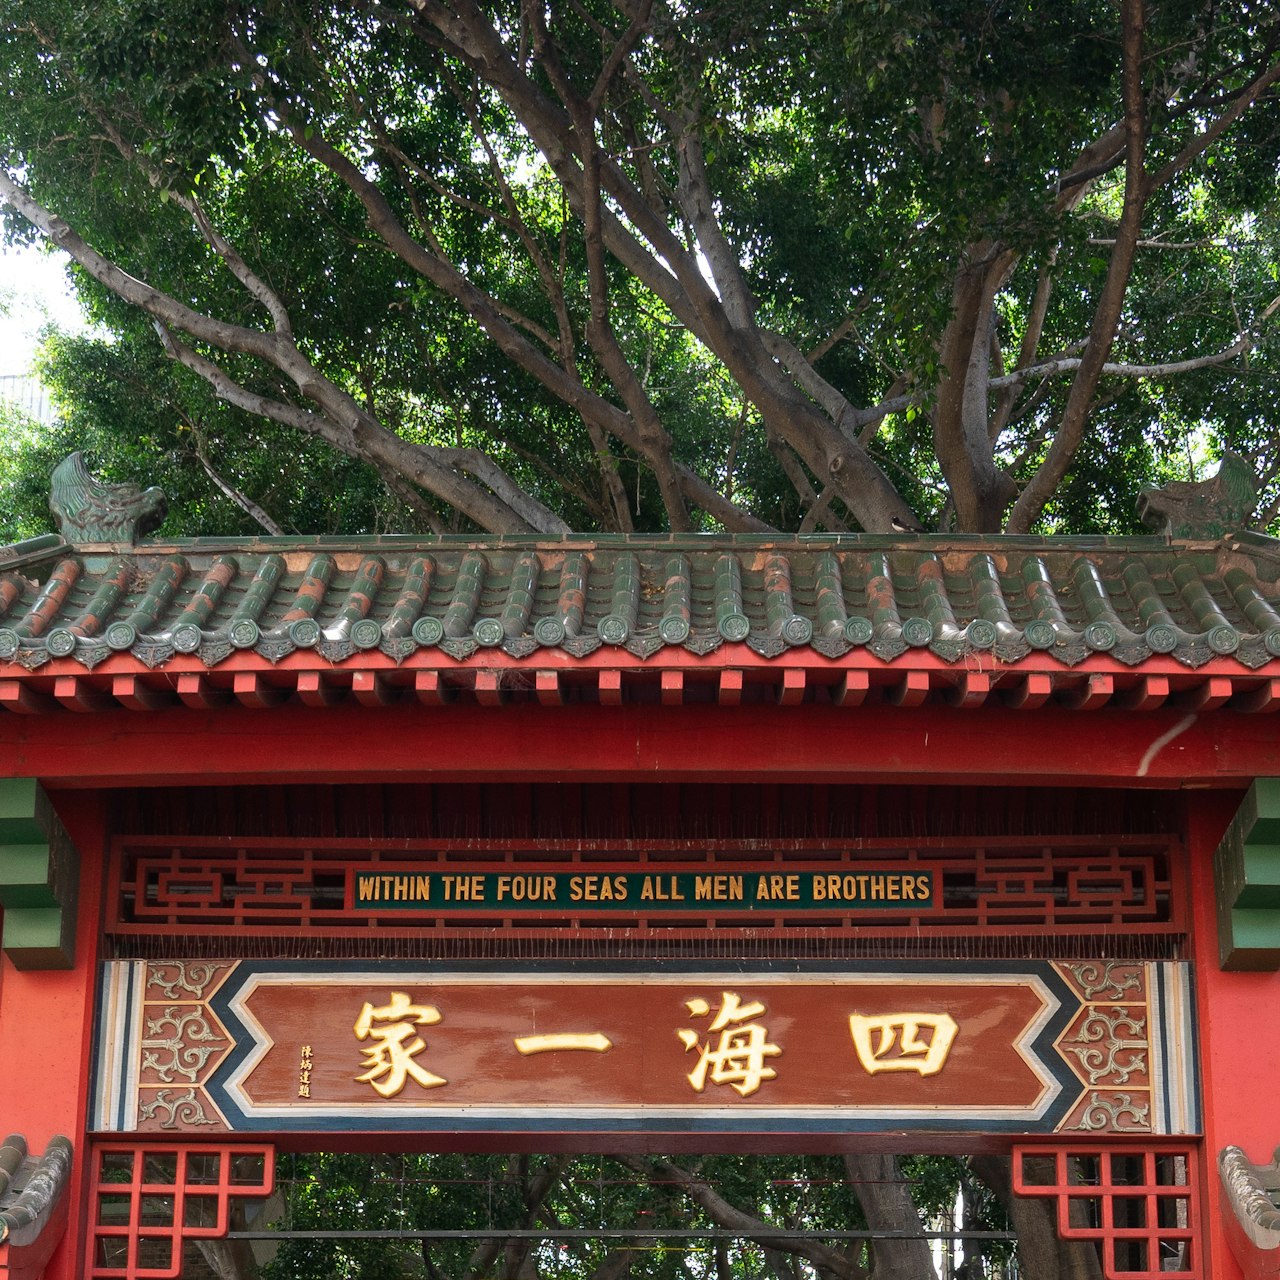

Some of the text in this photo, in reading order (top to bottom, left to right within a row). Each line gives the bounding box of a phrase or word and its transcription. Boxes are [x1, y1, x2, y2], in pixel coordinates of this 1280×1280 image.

[359, 875, 930, 901] WITHIN THE FOUR SEAS ALL MEN ARE BROTHERS
